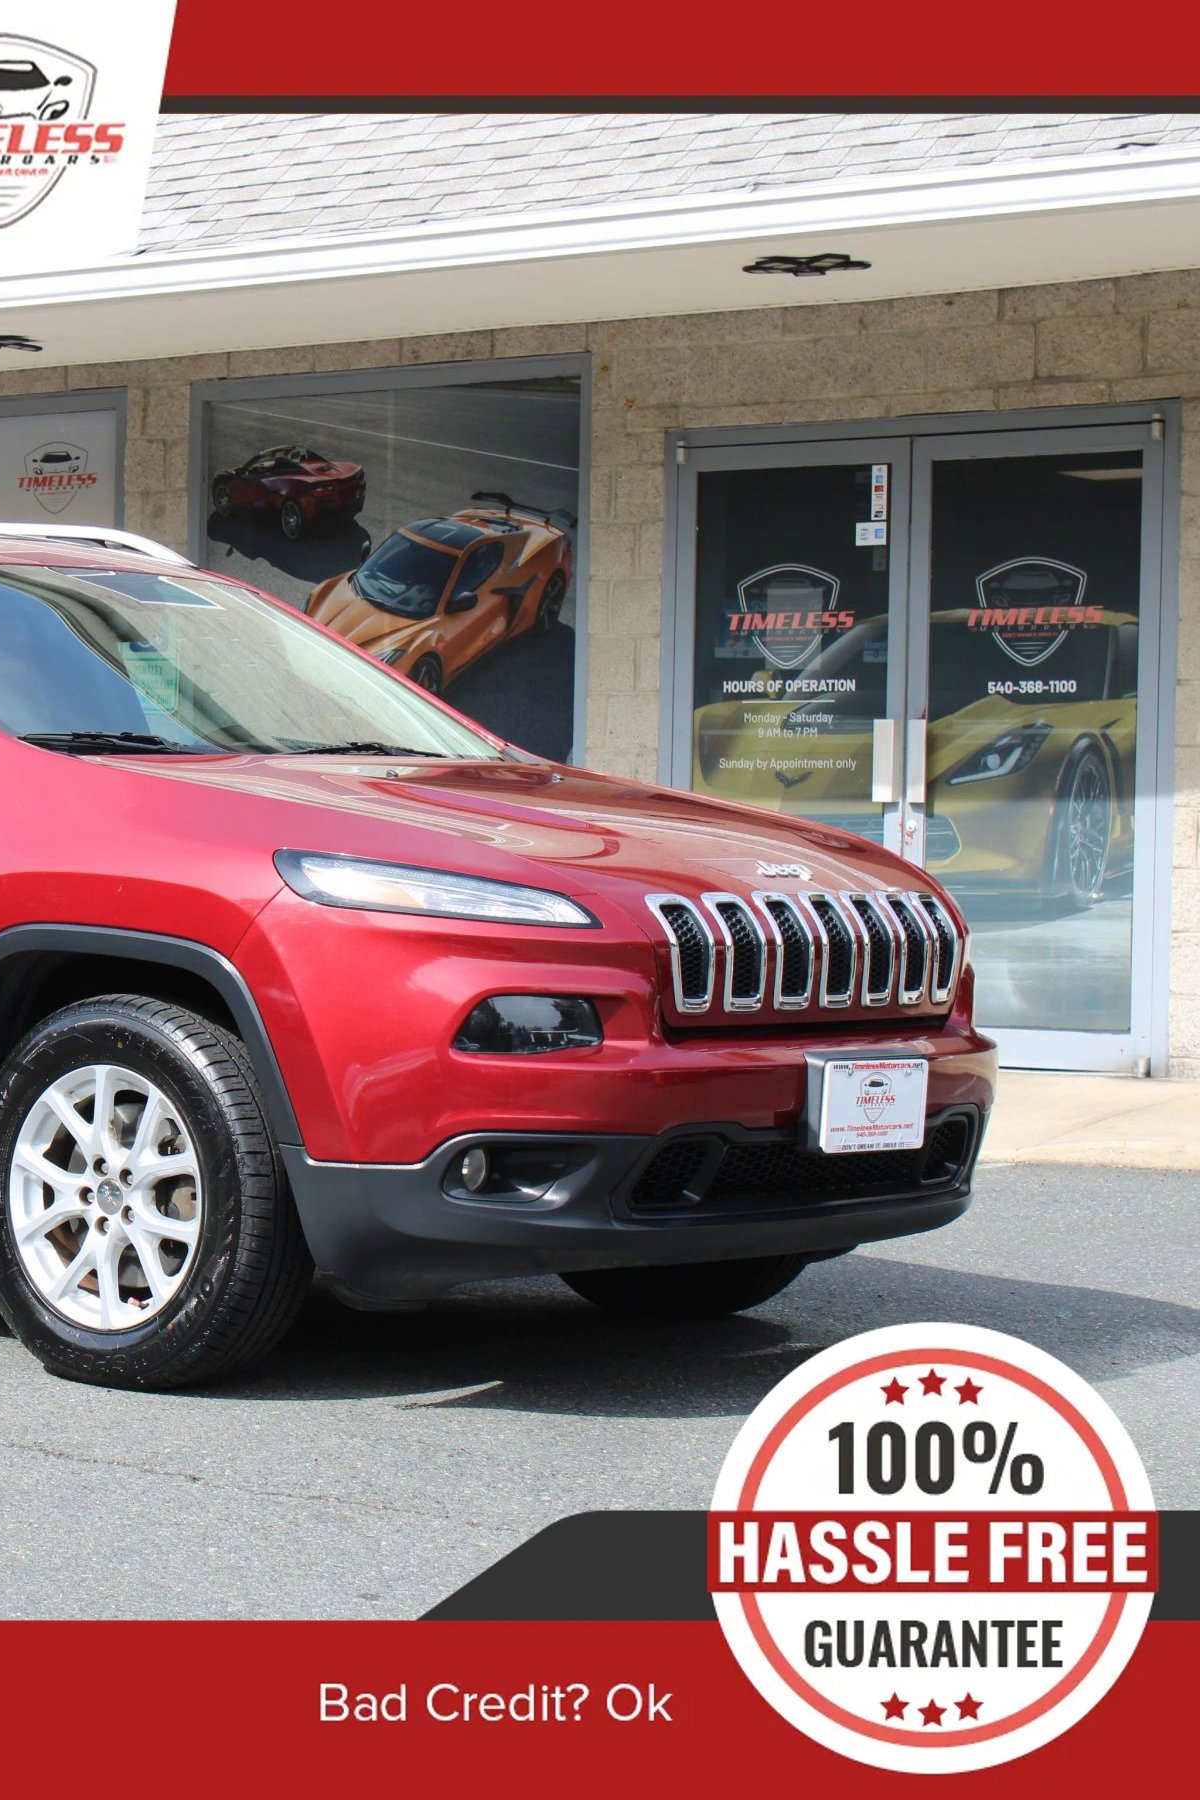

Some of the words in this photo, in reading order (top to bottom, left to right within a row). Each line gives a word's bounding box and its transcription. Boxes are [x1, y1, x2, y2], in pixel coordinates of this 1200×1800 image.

[17, 473, 97, 488] TIMELESS
[728, 611, 855, 631] TIMELESS
[967, 606, 1104, 627] TIMELESS
[723, 680, 765, 693] HOURS
[767, 680, 783, 693] OF
[785, 679, 856, 693] OPERATION
[987, 680, 1077, 694] 540-368-1100
[744, 712, 780, 725] Monday
[789, 711, 834, 725] Saturday
[758, 728, 764, 738] 9
[766, 728, 780, 738] AM
[783, 728, 793, 738] to
[795, 727, 802, 737] 7
[803, 727, 818, 738] PM
[719, 758, 755, 771] Sunday
[756, 758, 767, 771] by
[769, 757, 834, 771] Appointment
[835, 757, 857, 771] only
[755, 860, 812, 881] Jeep
[856, 1095, 895, 1104] TIMELESS
